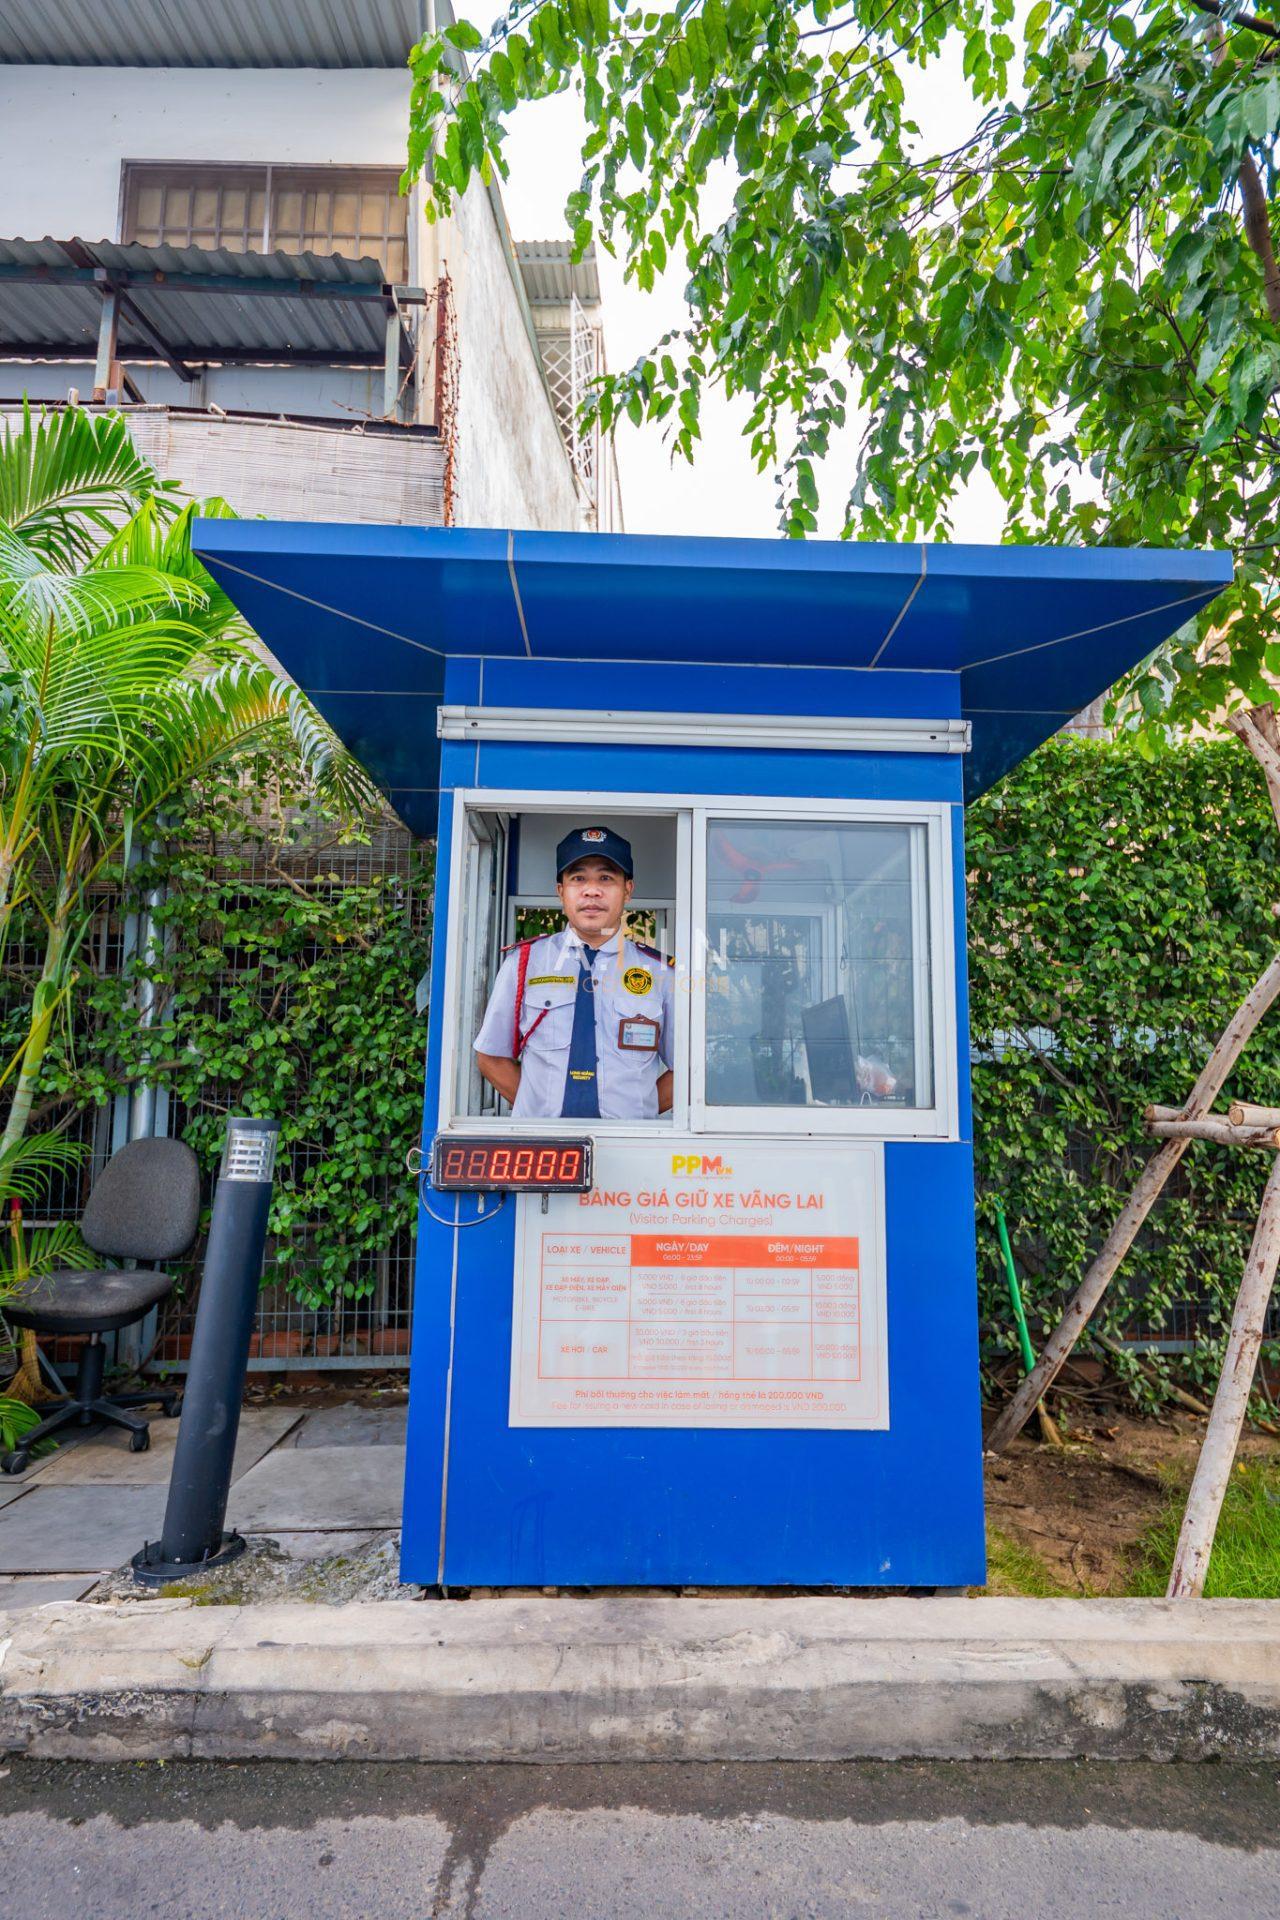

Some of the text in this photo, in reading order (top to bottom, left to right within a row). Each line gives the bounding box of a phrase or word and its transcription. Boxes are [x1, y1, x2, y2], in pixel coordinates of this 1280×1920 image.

[579, 1186, 823, 1209] BẢNG GIÁ GIỮ XE VÃNG LAI
[630, 1212, 773, 1227] (Visitor Parking Charges)
[570, 1246, 581, 1254] XE
[590, 1246, 626, 1254] VEHICLE
[656, 1241, 709, 1252] NGÀY/DAY
[768, 1242, 825, 1254] ĐÊM/NIGHT
[638, 1390, 653, 1398] cho
[768, 1392, 803, 1400] 200.000
[806, 1392, 824, 1400] VND
